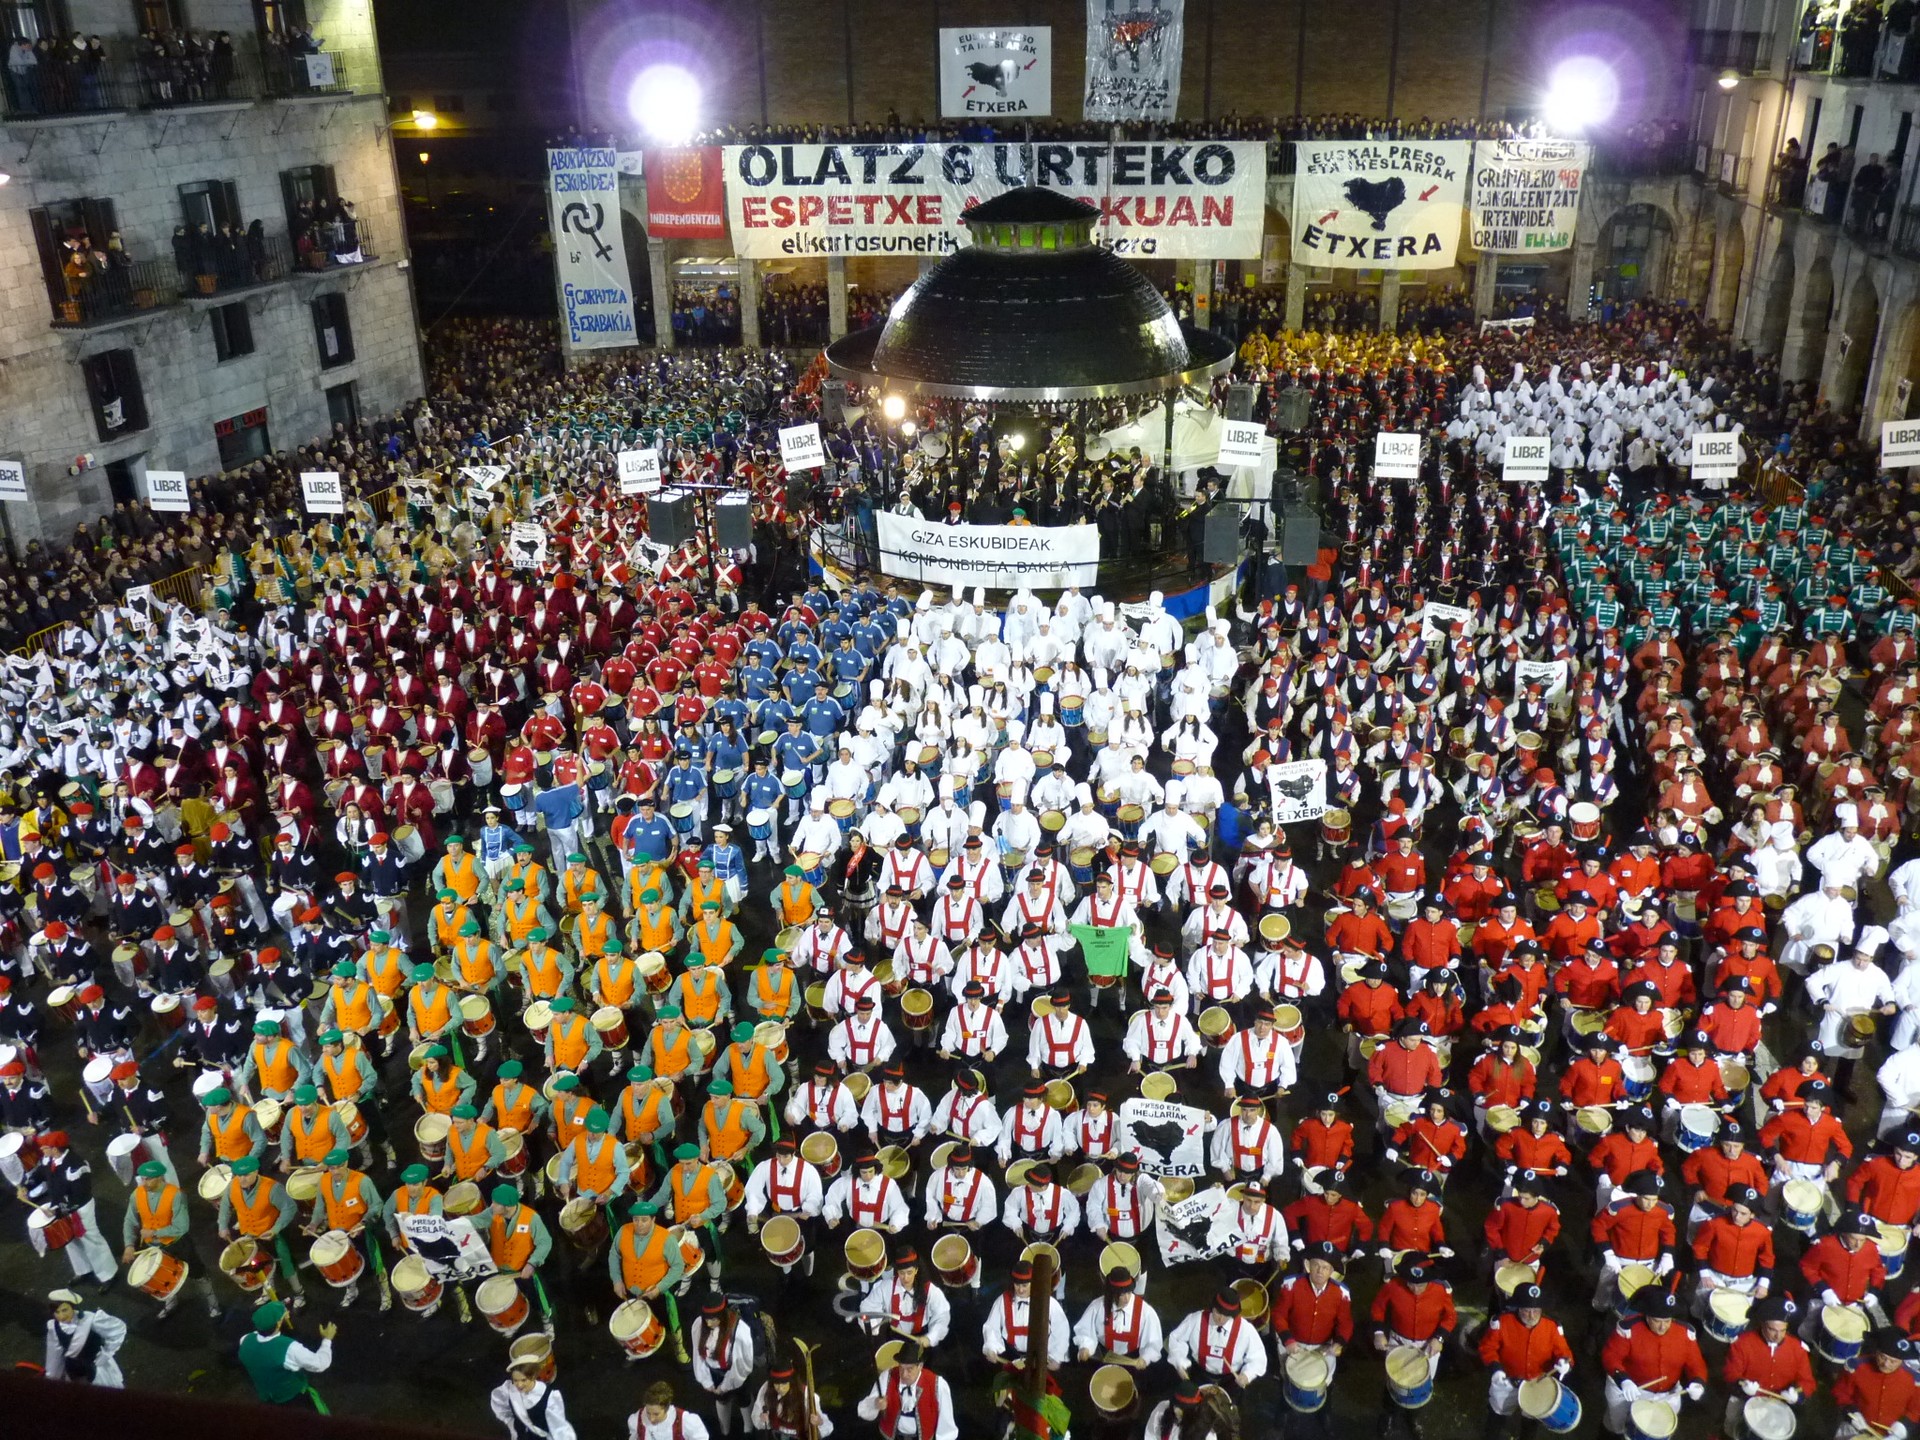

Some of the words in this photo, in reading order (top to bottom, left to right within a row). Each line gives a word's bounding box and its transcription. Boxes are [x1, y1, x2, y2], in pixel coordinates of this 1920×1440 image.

[966, 99, 1028, 113] ETXERA
[1312, 146, 1382, 164] EUSKAL
[1389, 145, 1446, 166] PRESO
[738, 145, 925, 187] OLATZ
[942, 144, 975, 186] 6
[994, 144, 1236, 187] URTEKO
[1308, 164, 1341, 175] ETA
[1348, 158, 1456, 182] IHESLARIAK
[742, 194, 942, 229] ESPETXE
[1482, 210, 1555, 227] IRTENBIDEA
[649, 213, 721, 226] INDEPENDENTZIA
[1301, 223, 1442, 260] ETXERA
[1525, 232, 1569, 248] ELA-LAB
[575, 288, 628, 306] GORPUTZA
[786, 433, 817, 451] LIBRE
[1227, 429, 1258, 445] LIBRE
[1382, 442, 1414, 457] LIBRE
[1512, 445, 1545, 459] LIBRE
[1699, 441, 1733, 456] LIBRE
[625, 458, 655, 473] LIBRE
[153, 480, 182, 493] LIBRE
[308, 481, 337, 494] LIBRE
[911, 529, 944, 547] GIZA
[948, 535, 1055, 552] ESKUBIDEAK.
[1277, 806, 1323, 821] ETXERA
[1140, 1102, 1165, 1111] PRESO
[1132, 1108, 1188, 1121] IHESLARIAK
[1140, 1162, 1200, 1176] TXERA
[412, 1218, 436, 1226] PRESO
[432, 1264, 491, 1280] TXERA
